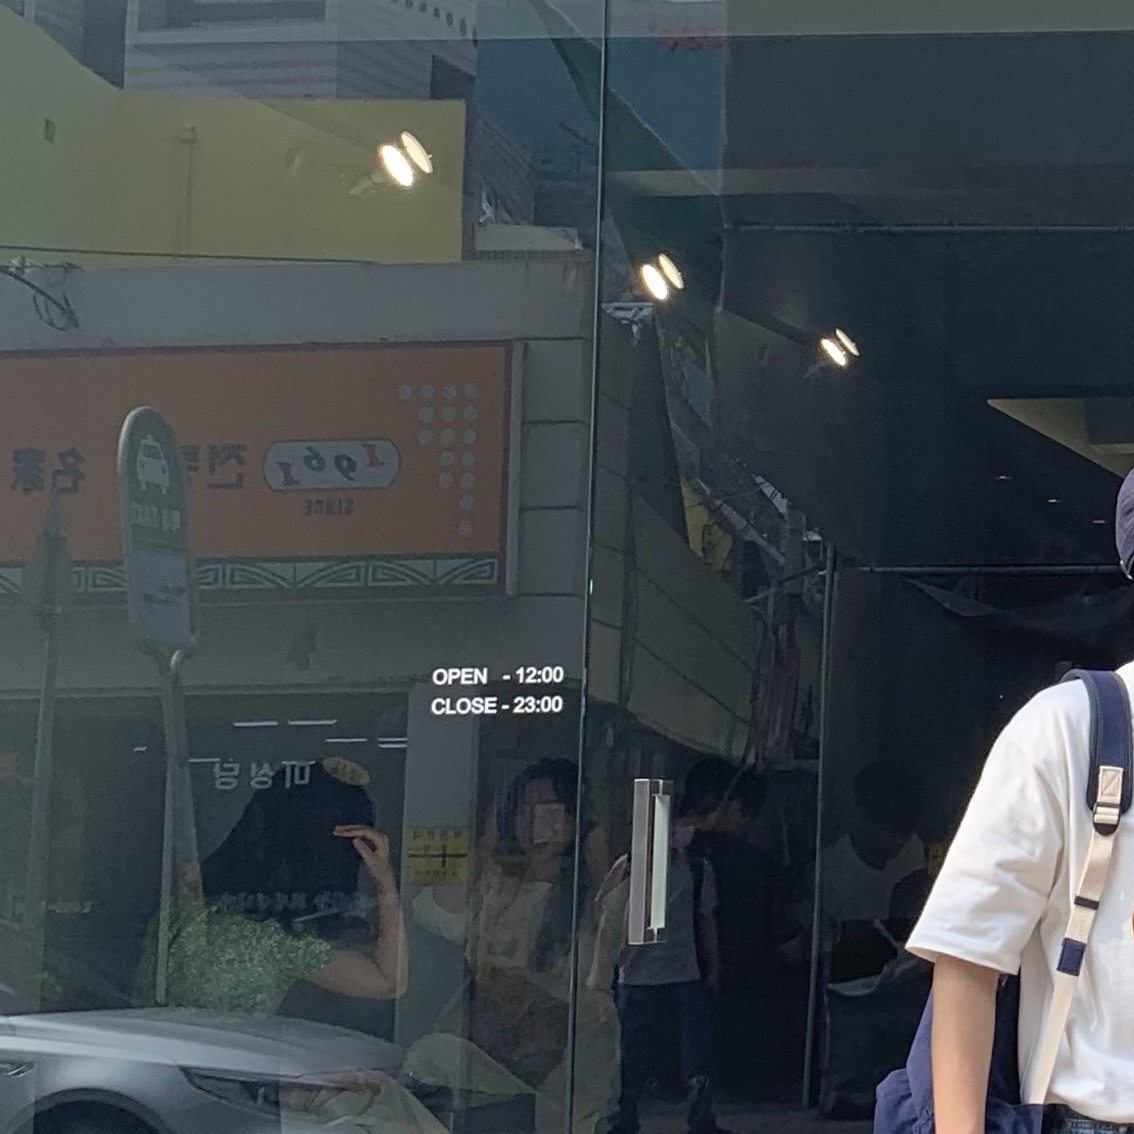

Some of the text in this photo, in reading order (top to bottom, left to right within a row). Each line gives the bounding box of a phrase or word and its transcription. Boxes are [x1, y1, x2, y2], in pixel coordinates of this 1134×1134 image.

[432, 668, 488, 686] OPEN
[516, 666, 565, 684] 12:00
[431, 696, 498, 715] CLOSE
[513, 695, 564, 714] 23:00
